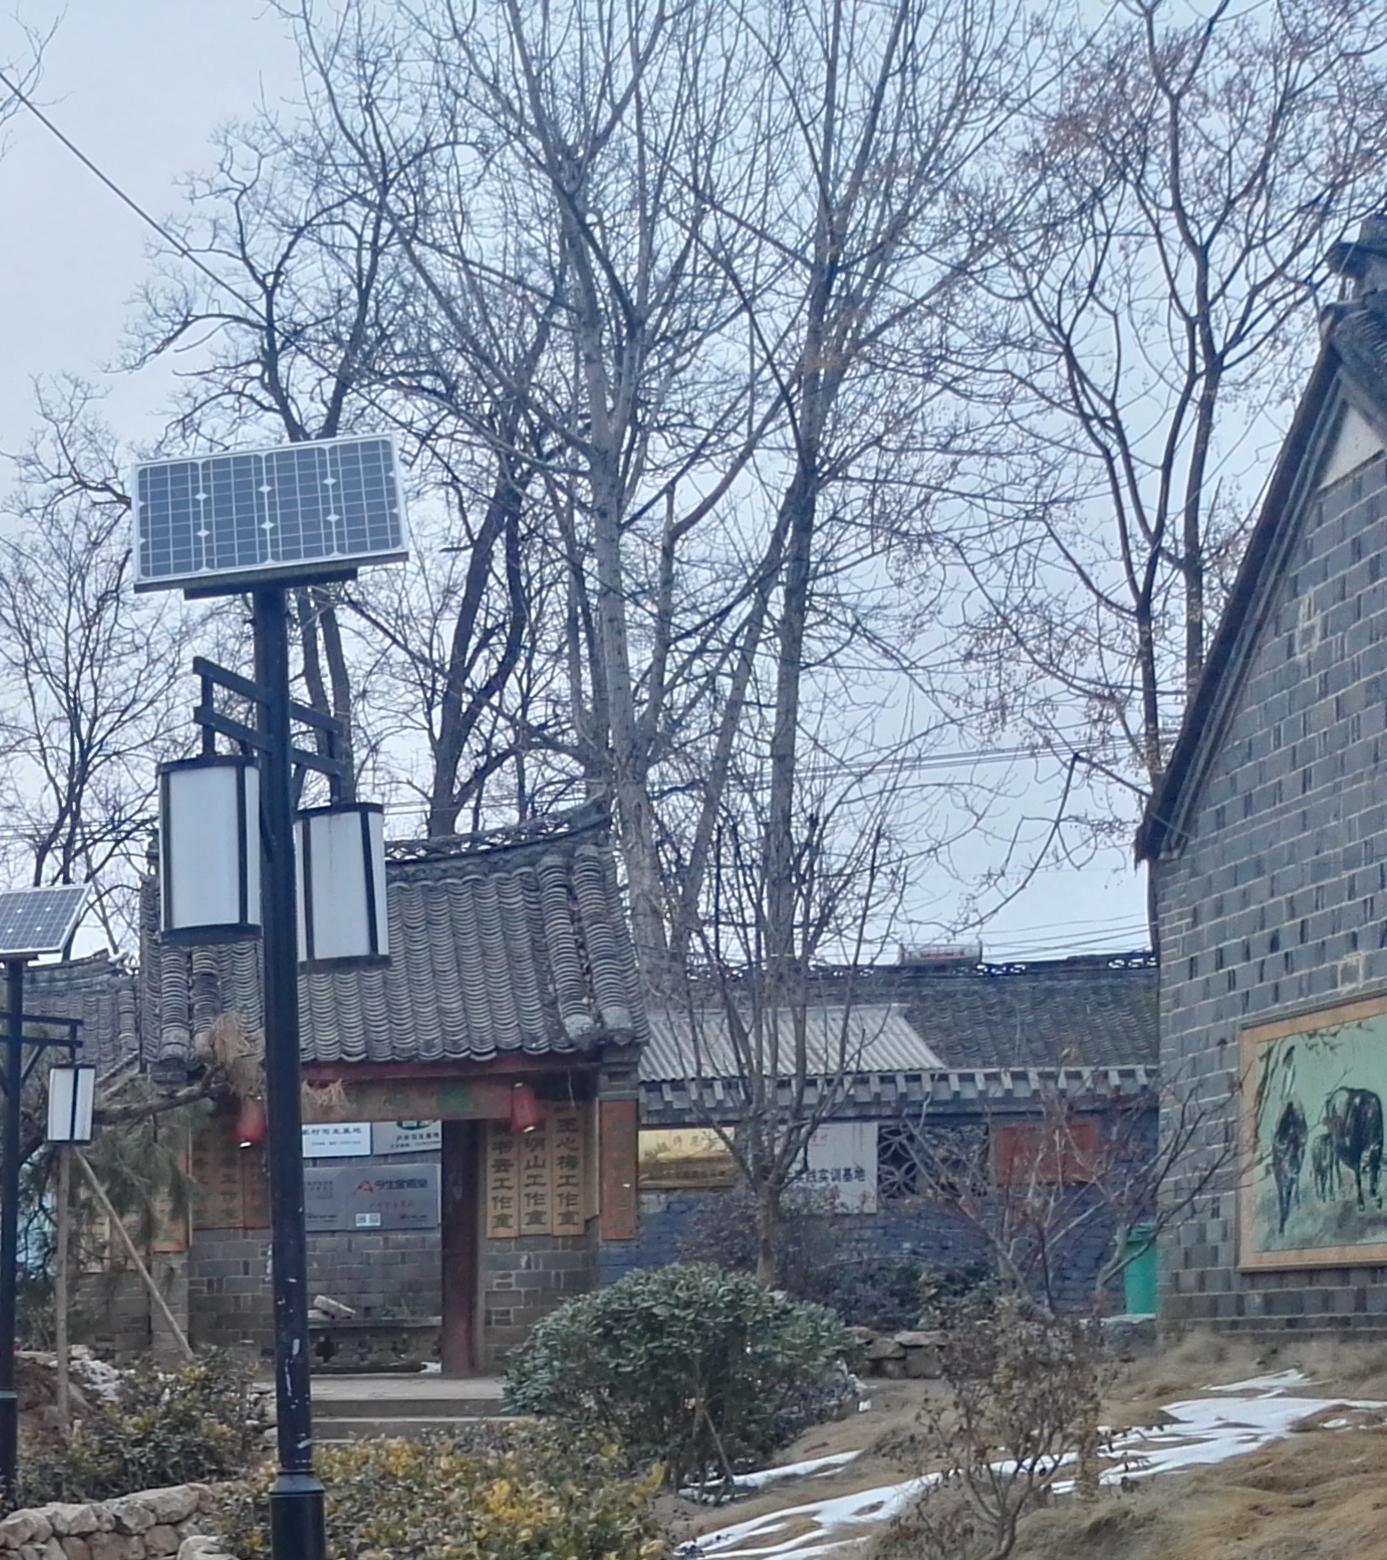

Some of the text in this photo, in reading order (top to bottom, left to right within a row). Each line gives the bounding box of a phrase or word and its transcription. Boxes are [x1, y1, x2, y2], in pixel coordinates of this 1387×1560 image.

[524, 1119, 547, 1225] 明山工作室
